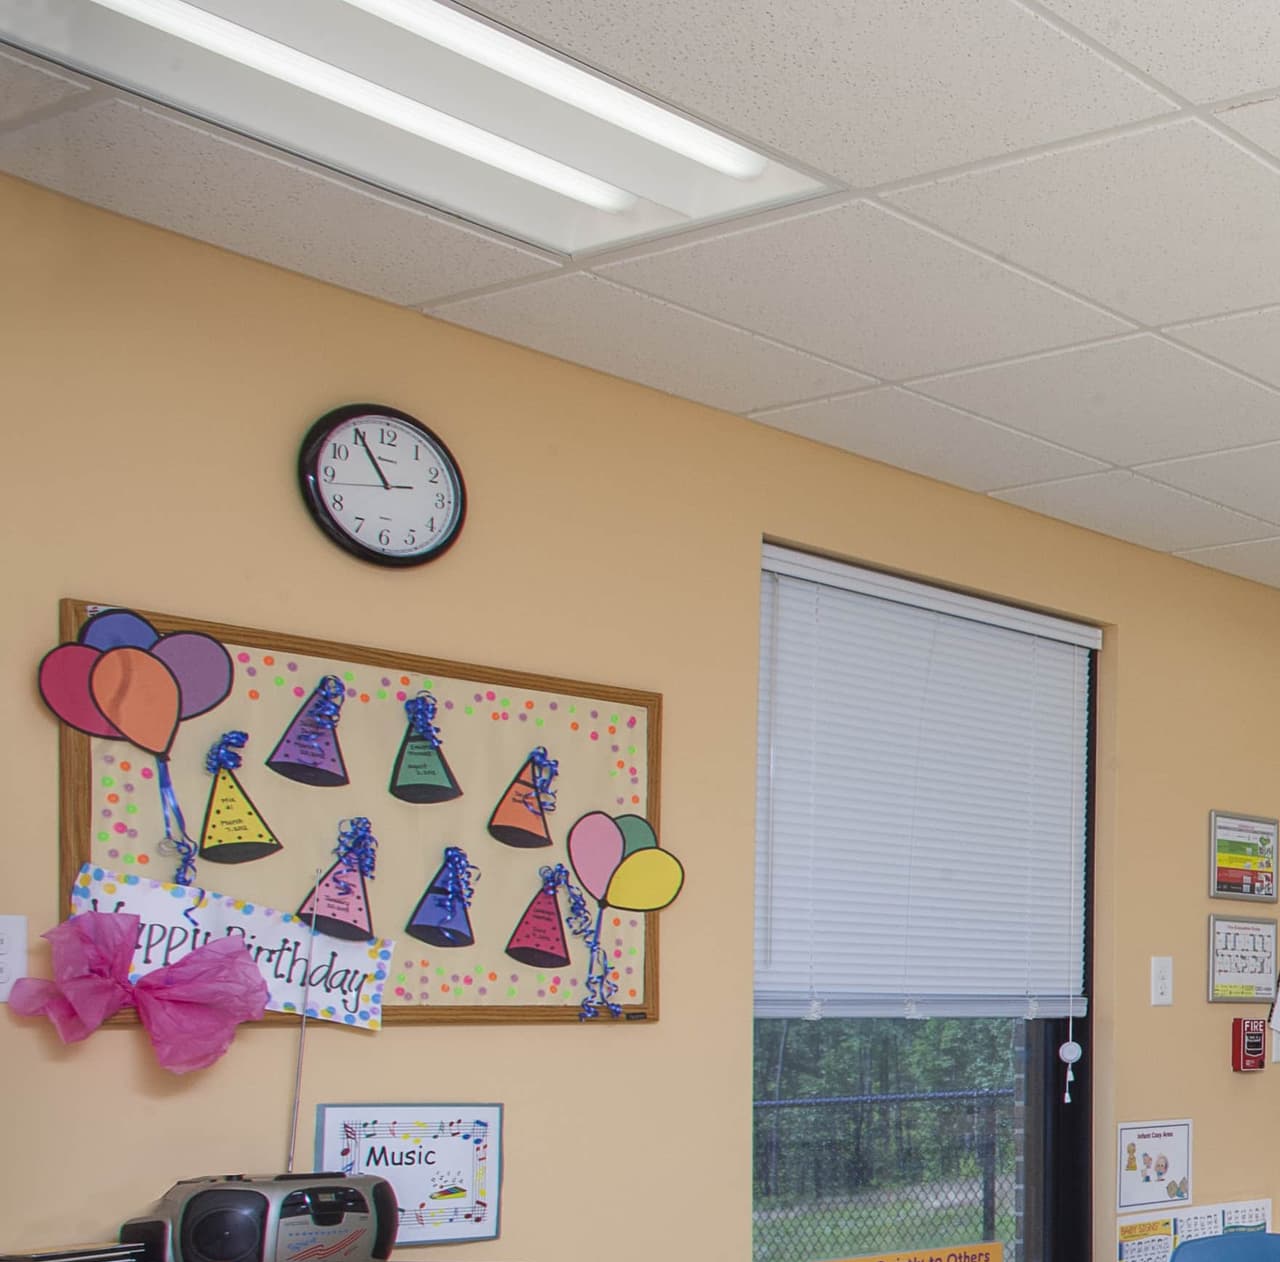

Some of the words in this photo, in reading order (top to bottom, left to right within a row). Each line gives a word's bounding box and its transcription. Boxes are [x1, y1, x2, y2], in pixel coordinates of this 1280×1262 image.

[380, 428, 398, 447] 12
[332, 443, 349, 461] 10
[414, 445, 420, 461] 1
[324, 466, 335, 482] 9
[429, 467, 439, 484] 2
[332, 494, 344, 511] 8
[434, 493, 445, 509] 3
[355, 516, 365, 533] 7
[425, 516, 434, 533] 4
[379, 529, 391, 545] 6
[404, 529, 416, 545] 5
[1244, 1020, 1264, 1032] FIRE
[366, 1144, 436, 1167] Music
